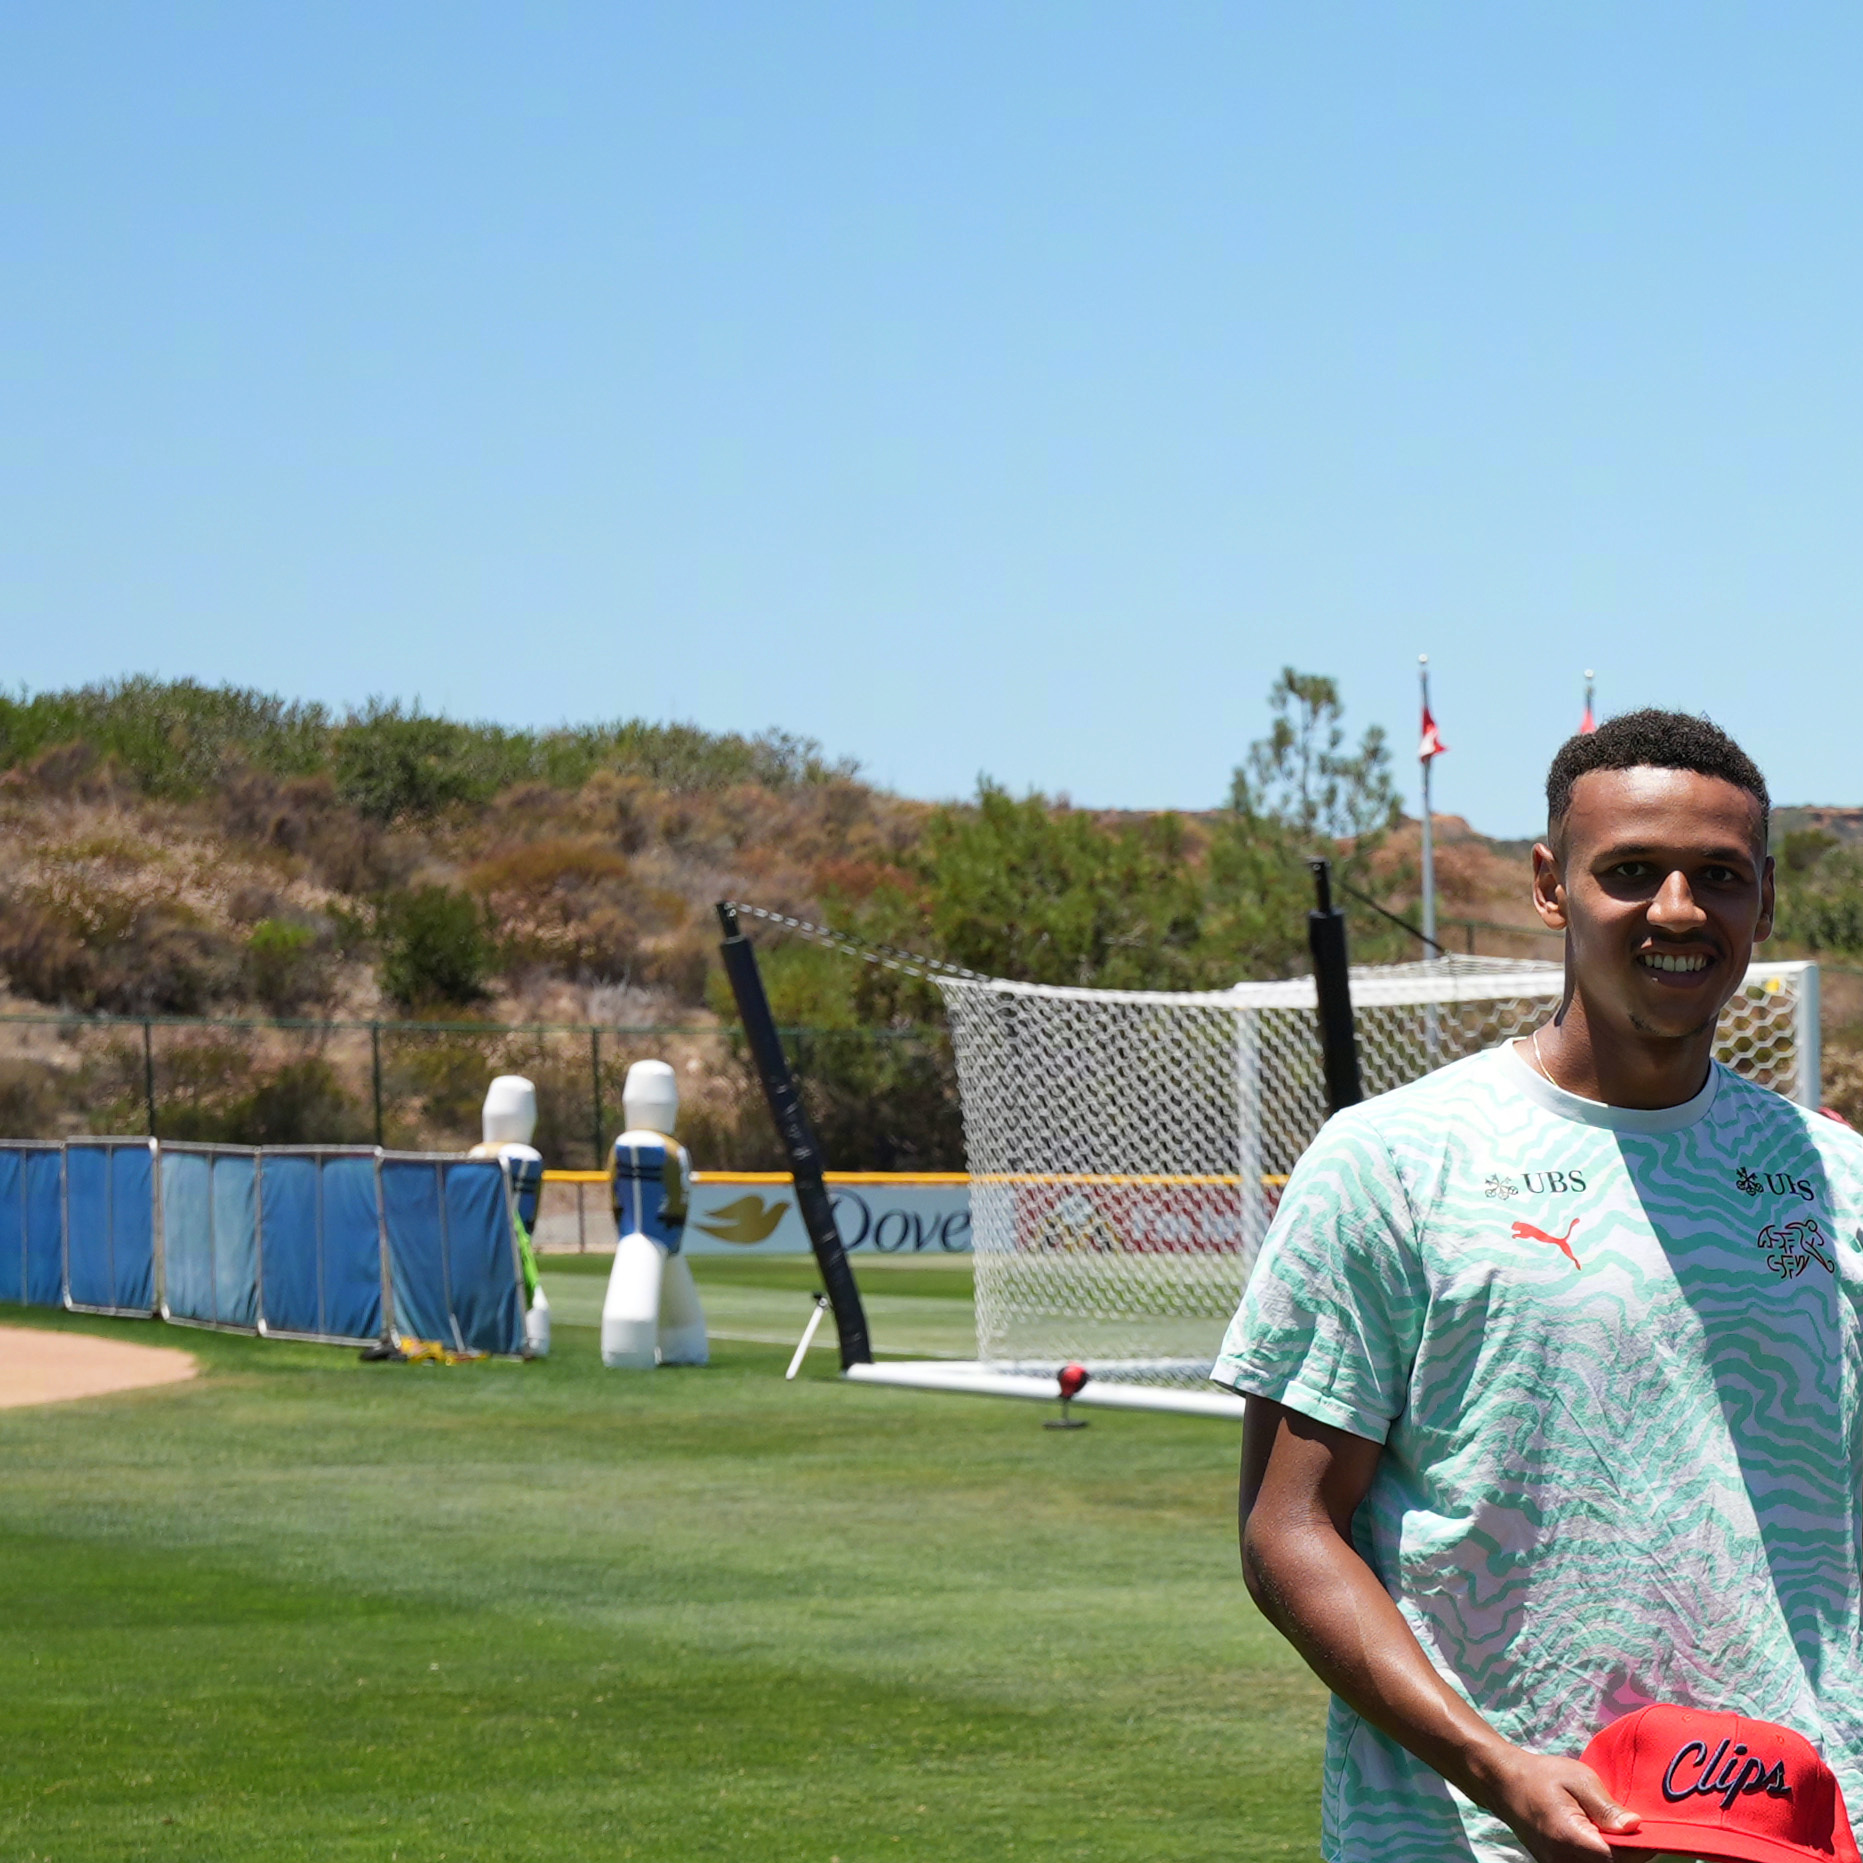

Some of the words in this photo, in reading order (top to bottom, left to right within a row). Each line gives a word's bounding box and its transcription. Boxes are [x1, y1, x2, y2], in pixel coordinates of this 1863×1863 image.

[1520, 1170, 1588, 1194] UBS
[828, 1186, 973, 1252] Dove
[1661, 1738, 1792, 1809] Clips
